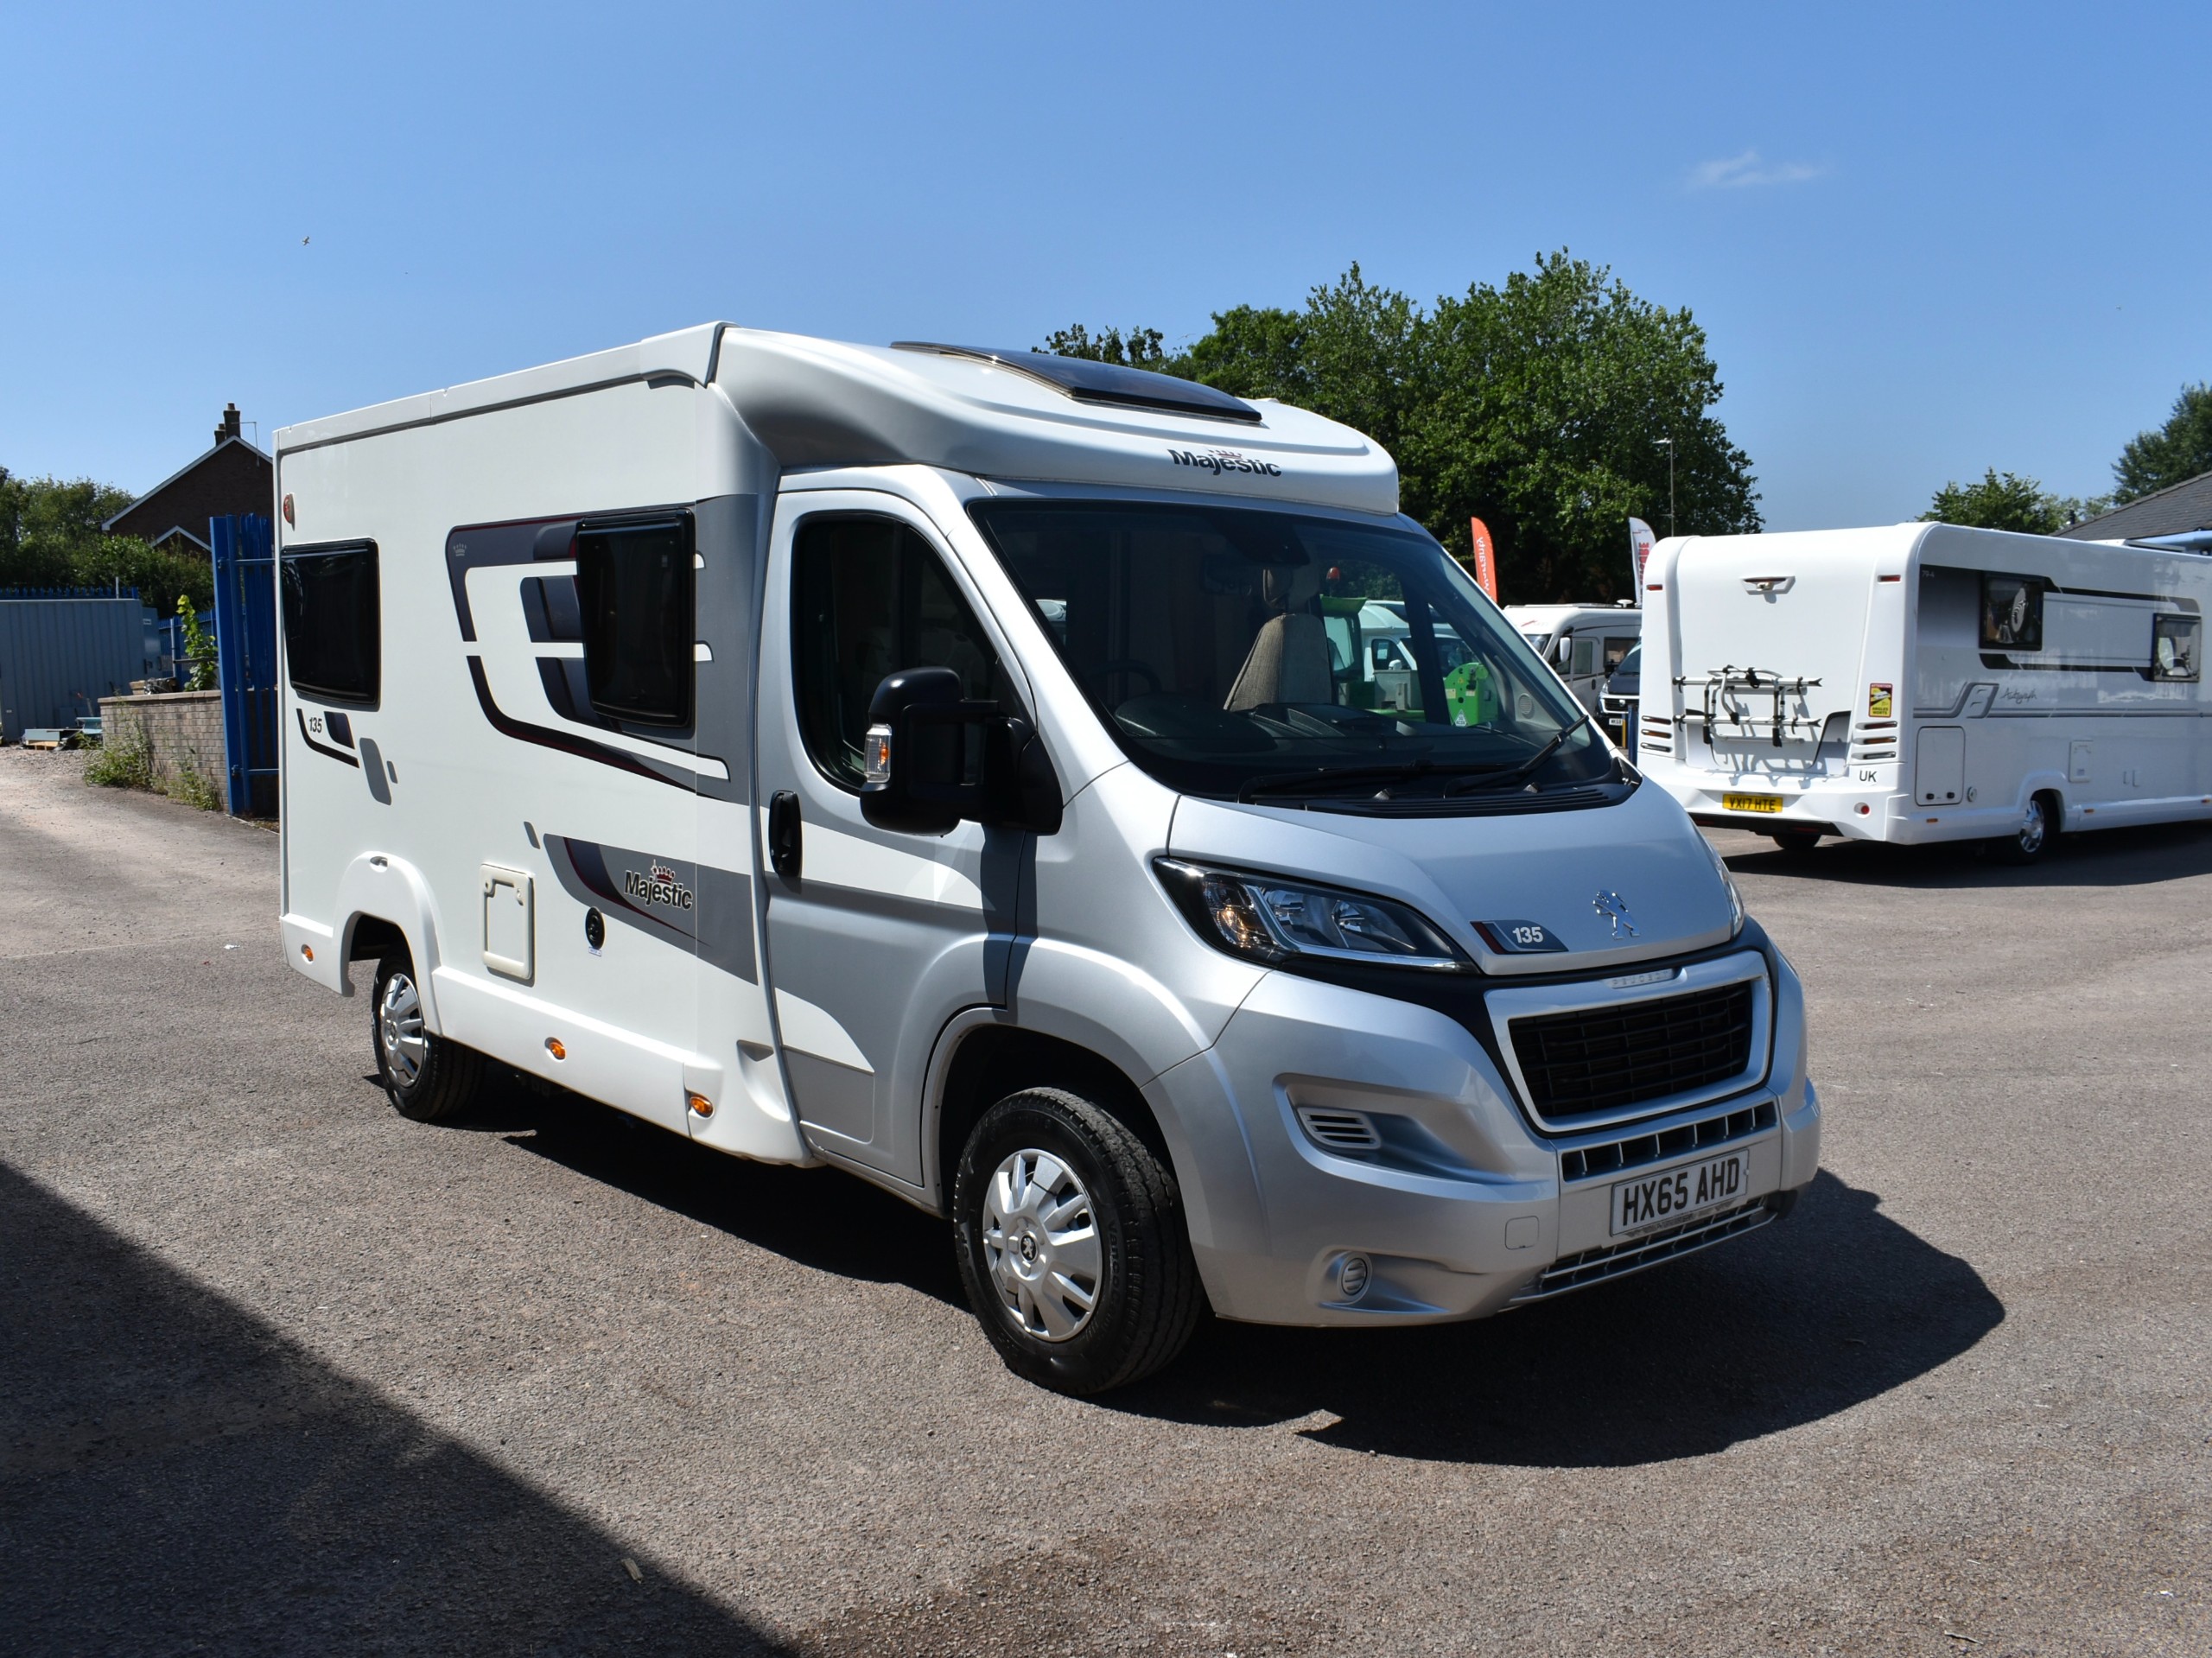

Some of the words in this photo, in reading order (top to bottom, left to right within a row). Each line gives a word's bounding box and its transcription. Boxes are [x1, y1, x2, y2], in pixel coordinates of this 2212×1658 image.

[1167, 448, 1281, 477] Majestic
[309, 717, 322, 734] 135
[1859, 770, 1877, 783] UK
[1729, 797, 1752, 810] VX17
[1755, 798, 1777, 810] HTE
[624, 869, 693, 911] Majestic
[1512, 926, 1544, 943] 135
[1623, 1172, 1688, 1226] HX65
[1695, 1157, 1740, 1204] AHD
